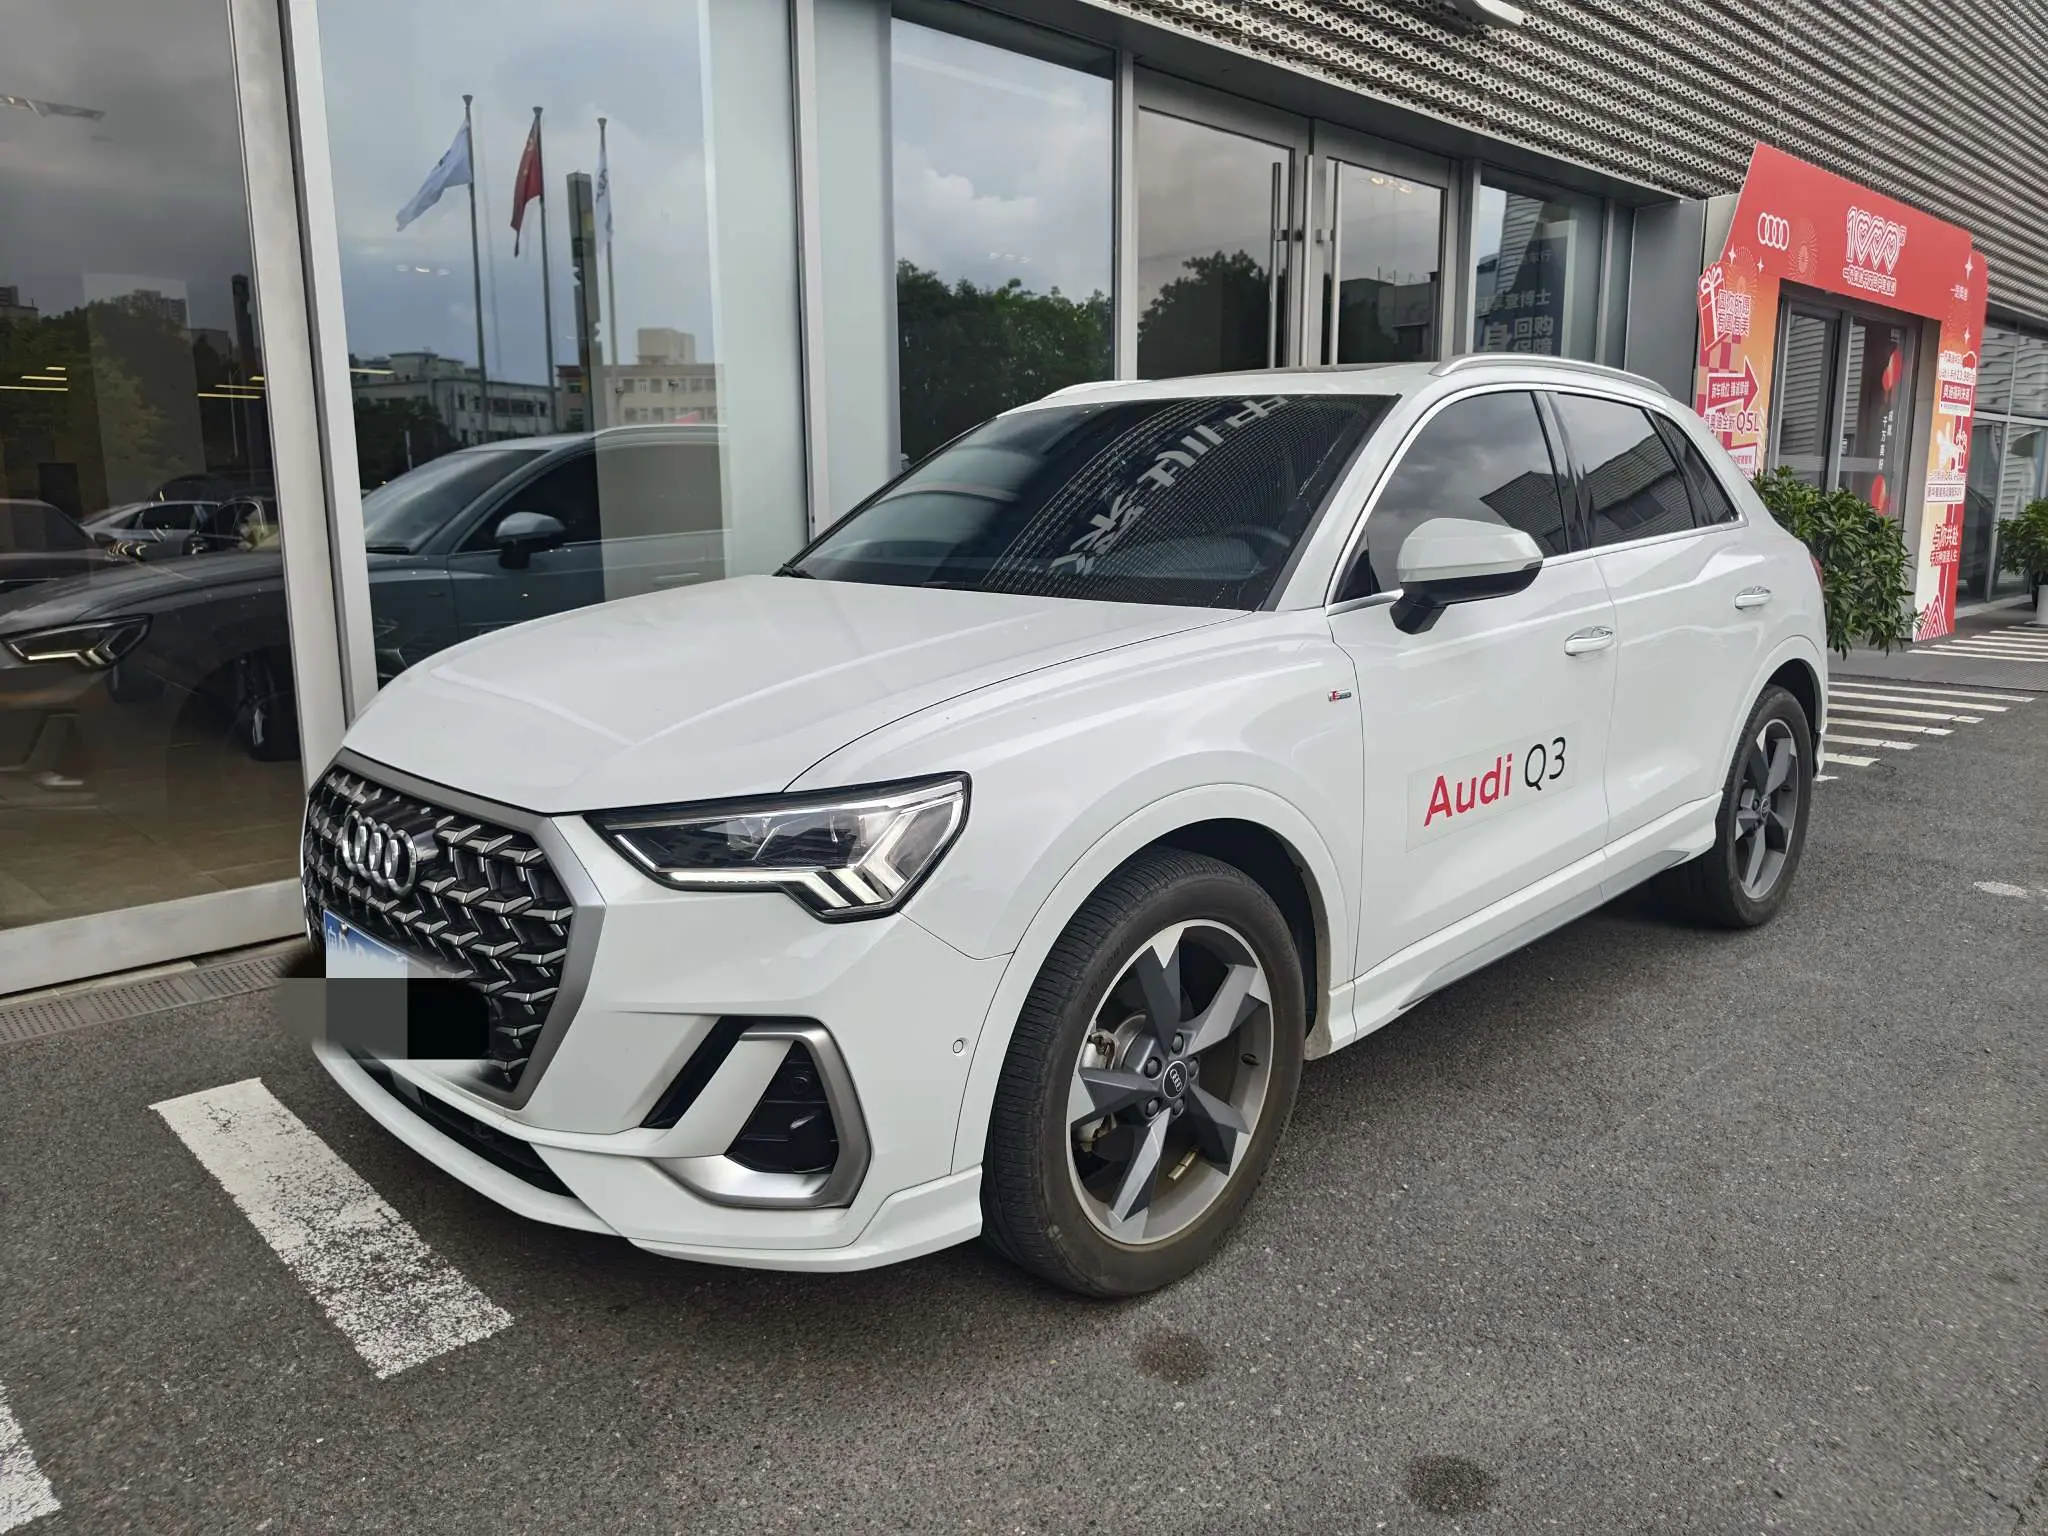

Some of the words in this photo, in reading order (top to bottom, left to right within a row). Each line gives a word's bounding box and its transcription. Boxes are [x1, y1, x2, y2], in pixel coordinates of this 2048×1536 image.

[1514, 315, 1554, 340] 回购
[1737, 410, 1760, 434] Q5L
[1424, 753, 1512, 826] Audi
[1524, 737, 1566, 791] Q3
